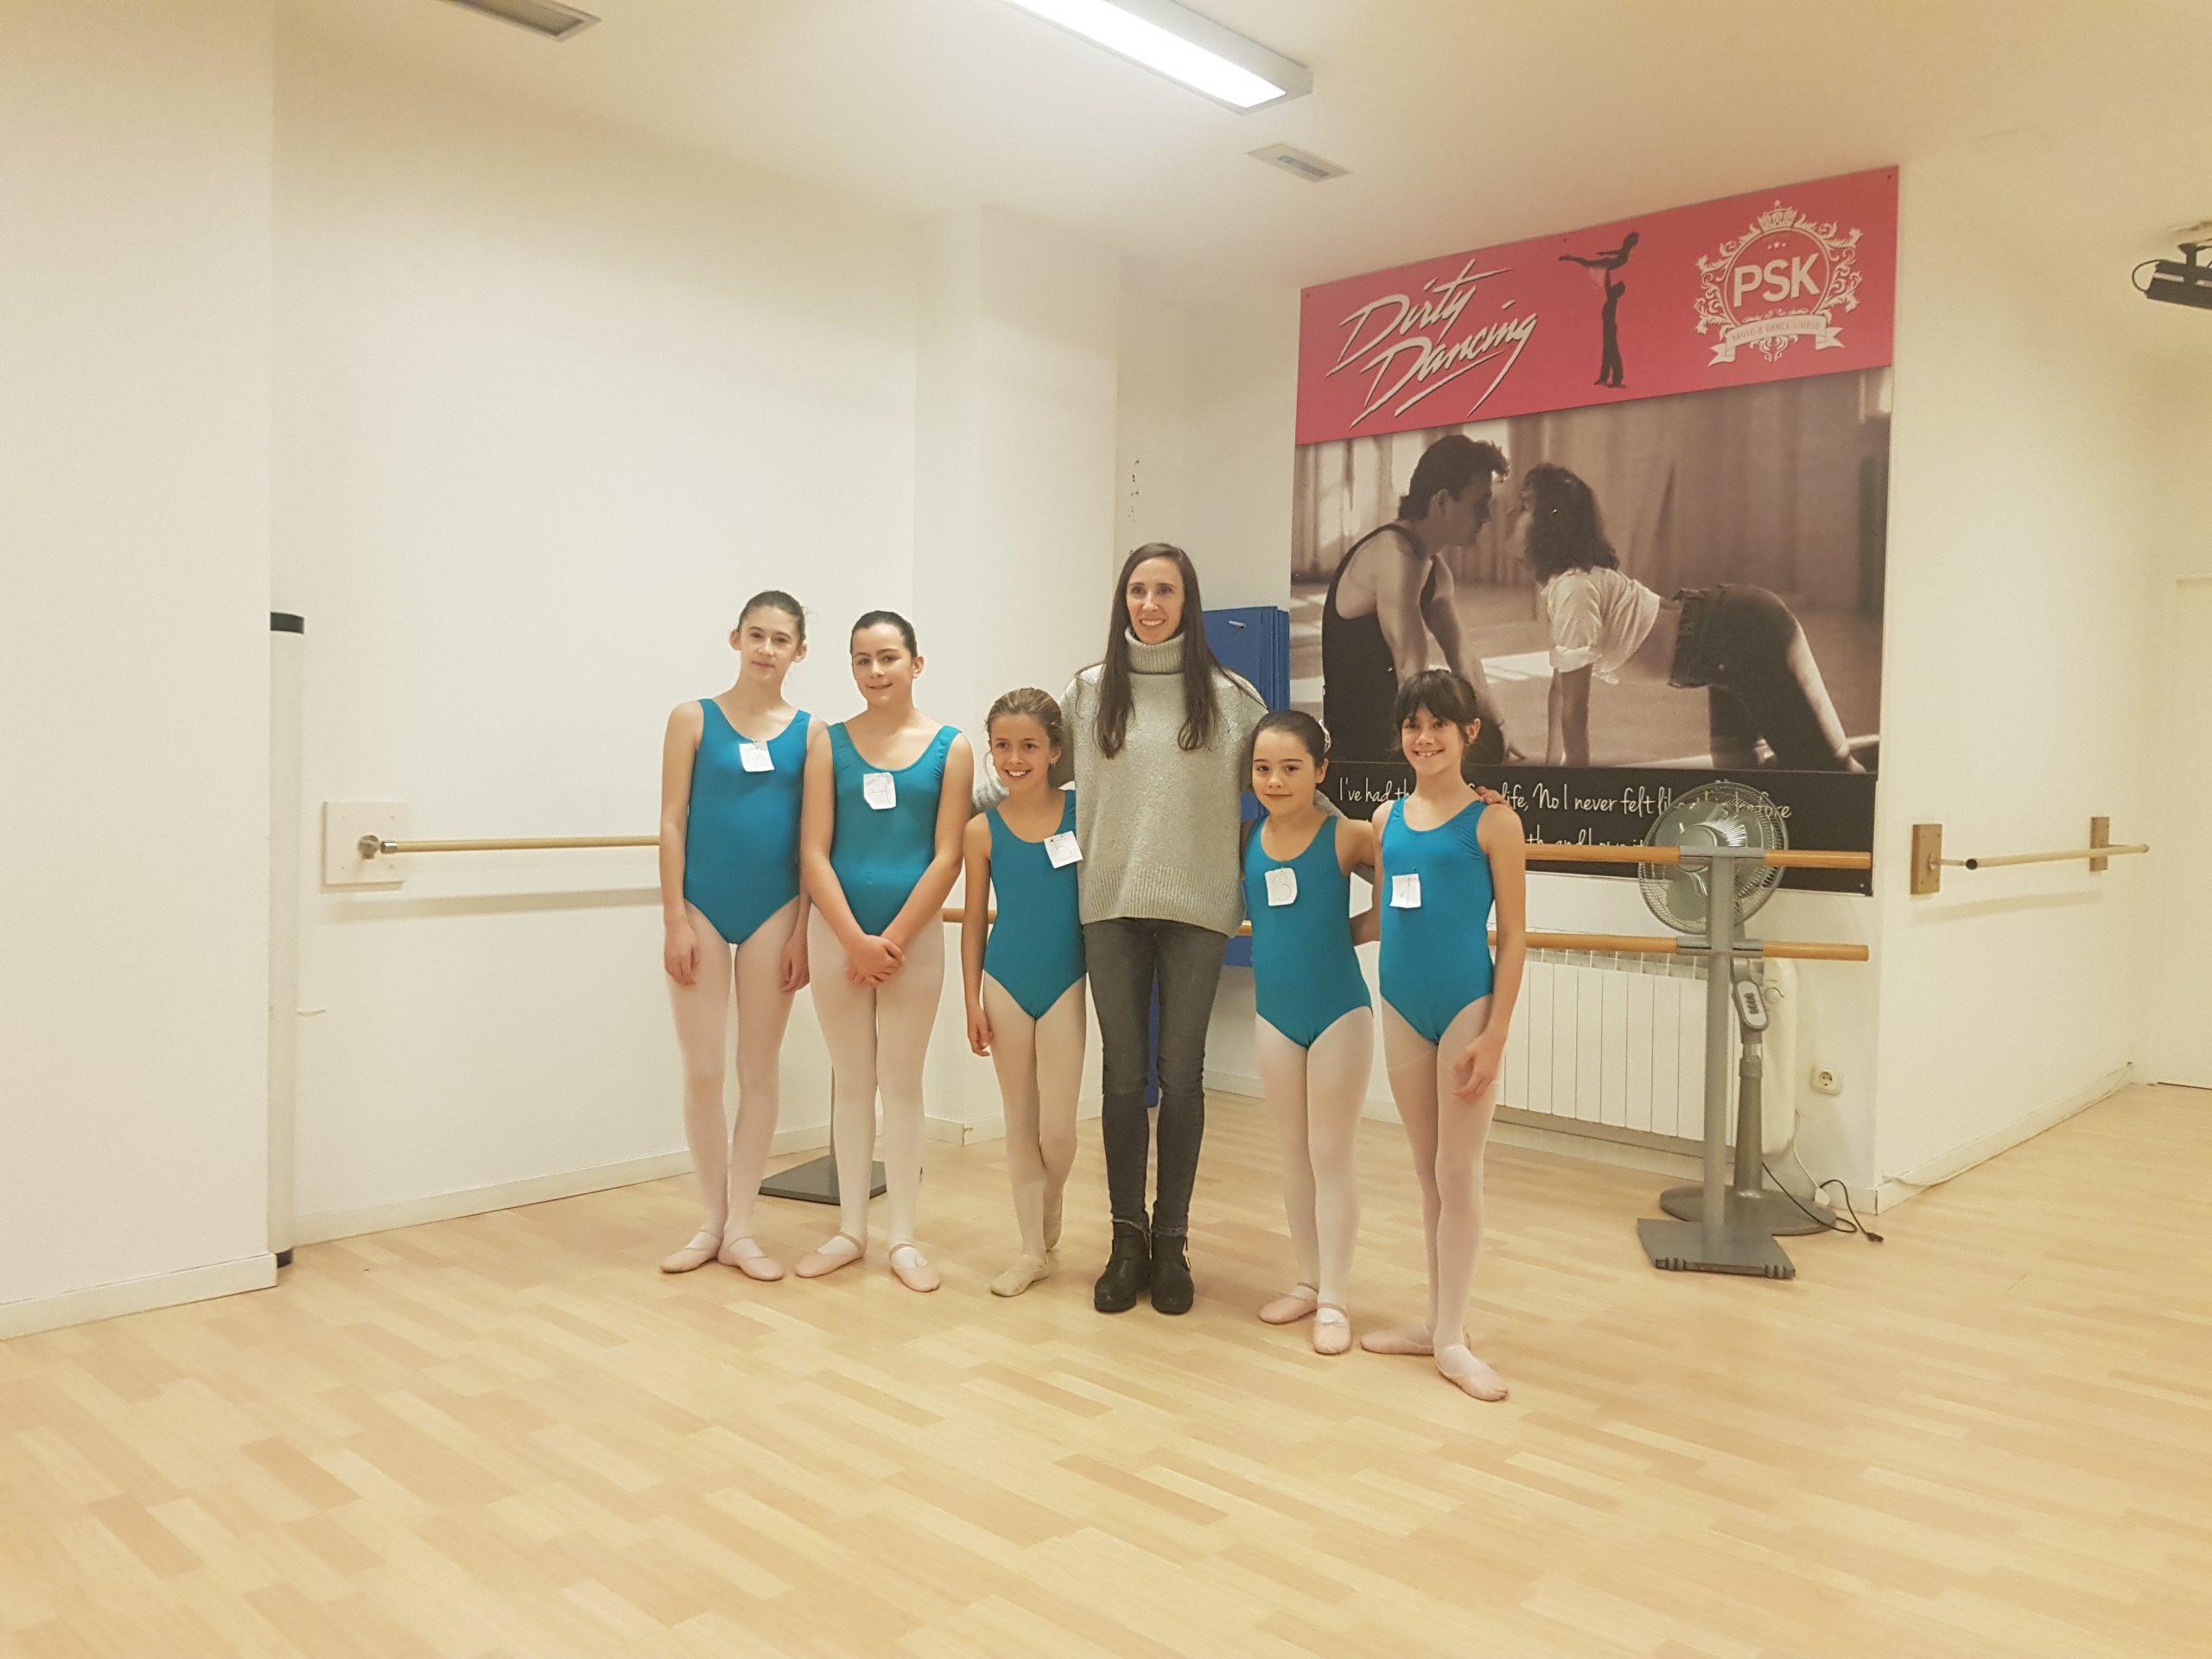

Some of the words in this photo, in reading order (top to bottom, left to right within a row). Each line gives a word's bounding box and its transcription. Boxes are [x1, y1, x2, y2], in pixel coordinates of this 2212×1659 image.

[1733, 252, 1821, 308] PSK
[1325, 258, 1514, 378] Dirty
[1793, 321, 1821, 331] STUDIO
[1348, 299, 1538, 429] Dancing
[1339, 777, 1363, 803] I've
[1365, 778, 1393, 803] had
[1502, 782, 1529, 812] life,
[1532, 782, 1559, 810] No
[1563, 783, 1568, 810] I
[1574, 797, 1618, 812] never
[1620, 785, 1656, 818] felt
